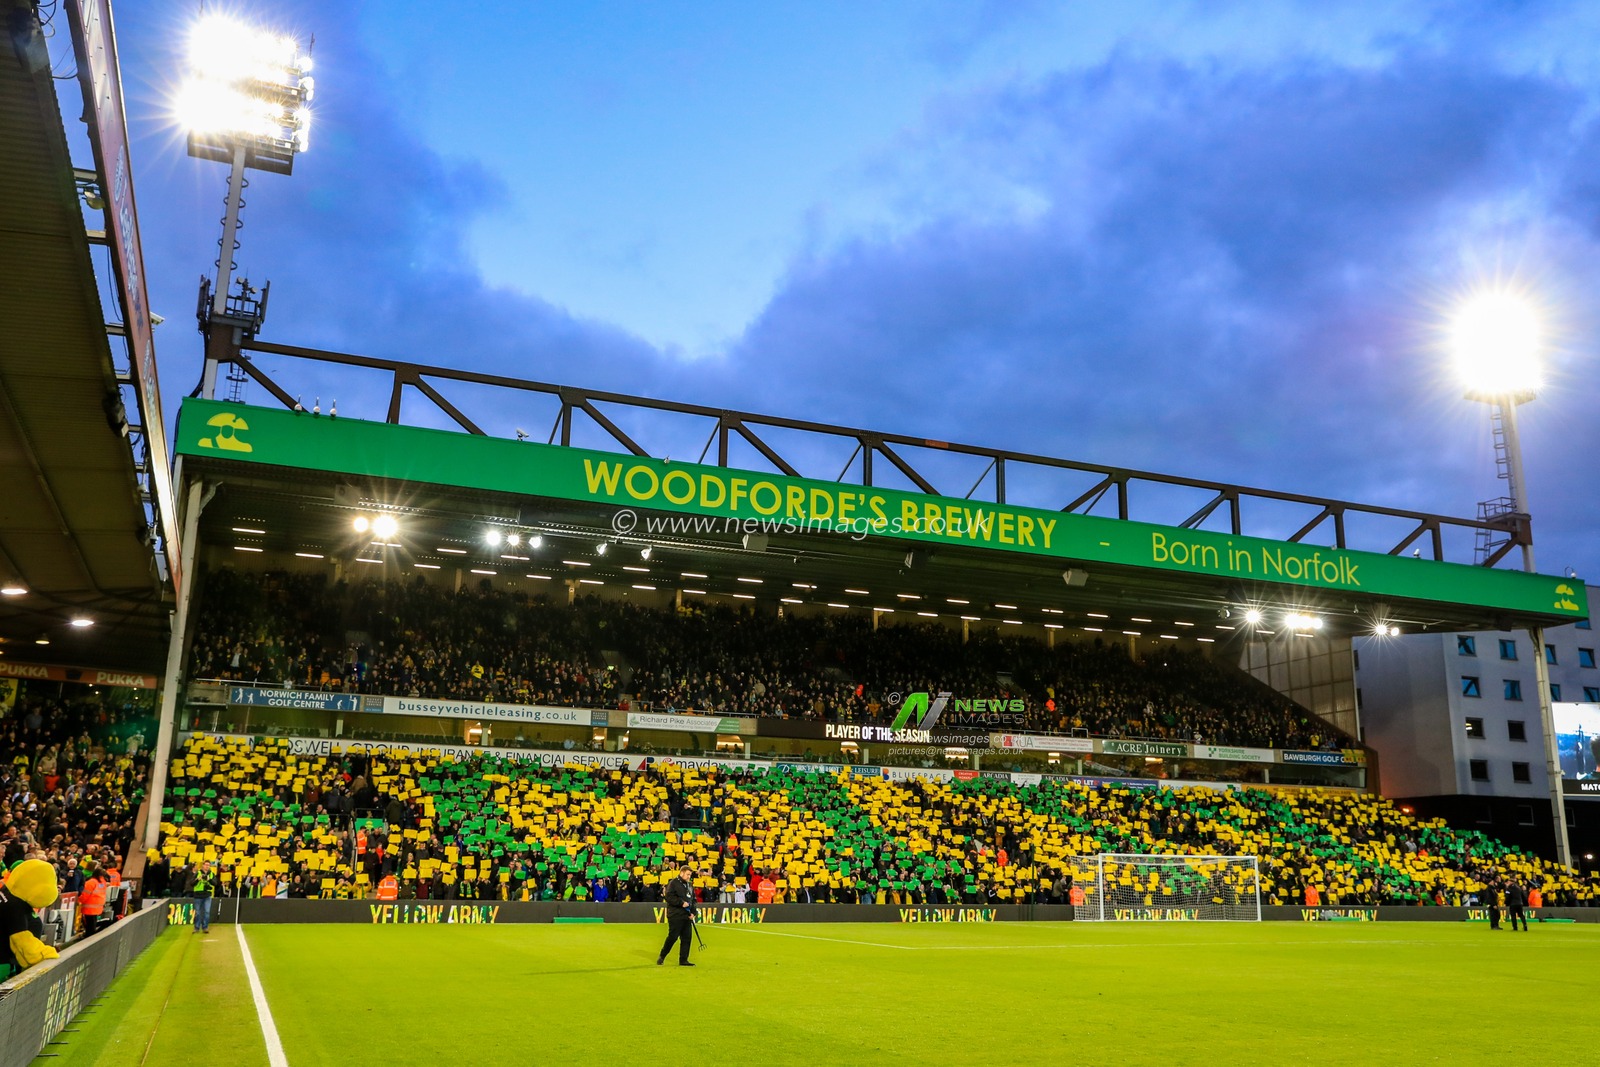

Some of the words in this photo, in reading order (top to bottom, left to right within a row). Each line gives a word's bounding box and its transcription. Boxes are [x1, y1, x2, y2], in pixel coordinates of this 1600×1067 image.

[584, 459, 887, 528] WOODFORDE'S
[902, 500, 1056, 548] BREWERY
[1152, 532, 1218, 568] Born
[1228, 541, 1252, 573] in
[1263, 547, 1360, 586] Norfolk
[96, 672, 144, 687] PUKKA
[260, 689, 302, 700] NORWICH
[304, 692, 335, 702] FAMILY
[268, 698, 293, 707] GOLF
[294, 700, 325, 709] CENTRE
[398, 700, 577, 722] busseyvehicleleasing.co.uk
[640, 716, 668, 724] Richard
[669, 717, 685, 725] Pike
[686, 718, 718, 727] Associates
[825, 724, 860, 739] PLAYER
[861, 726, 874, 740] OF
[875, 727, 893, 741] THE
[895, 729, 930, 743] SEASON
[1116, 743, 1142, 752] ACRE
[1144, 744, 1181, 756] Joinery
[1284, 753, 1321, 762] BAWBURGH
[1322, 755, 1339, 763] GOLF
[370, 904, 444, 924] YELLOW
[447, 905, 499, 924] ARMY
[721, 907, 766, 924] ARMY
[899, 908, 955, 923] YELLOW
[958, 909, 997, 923] ARMY
[1165, 909, 1199, 921] ARMY
